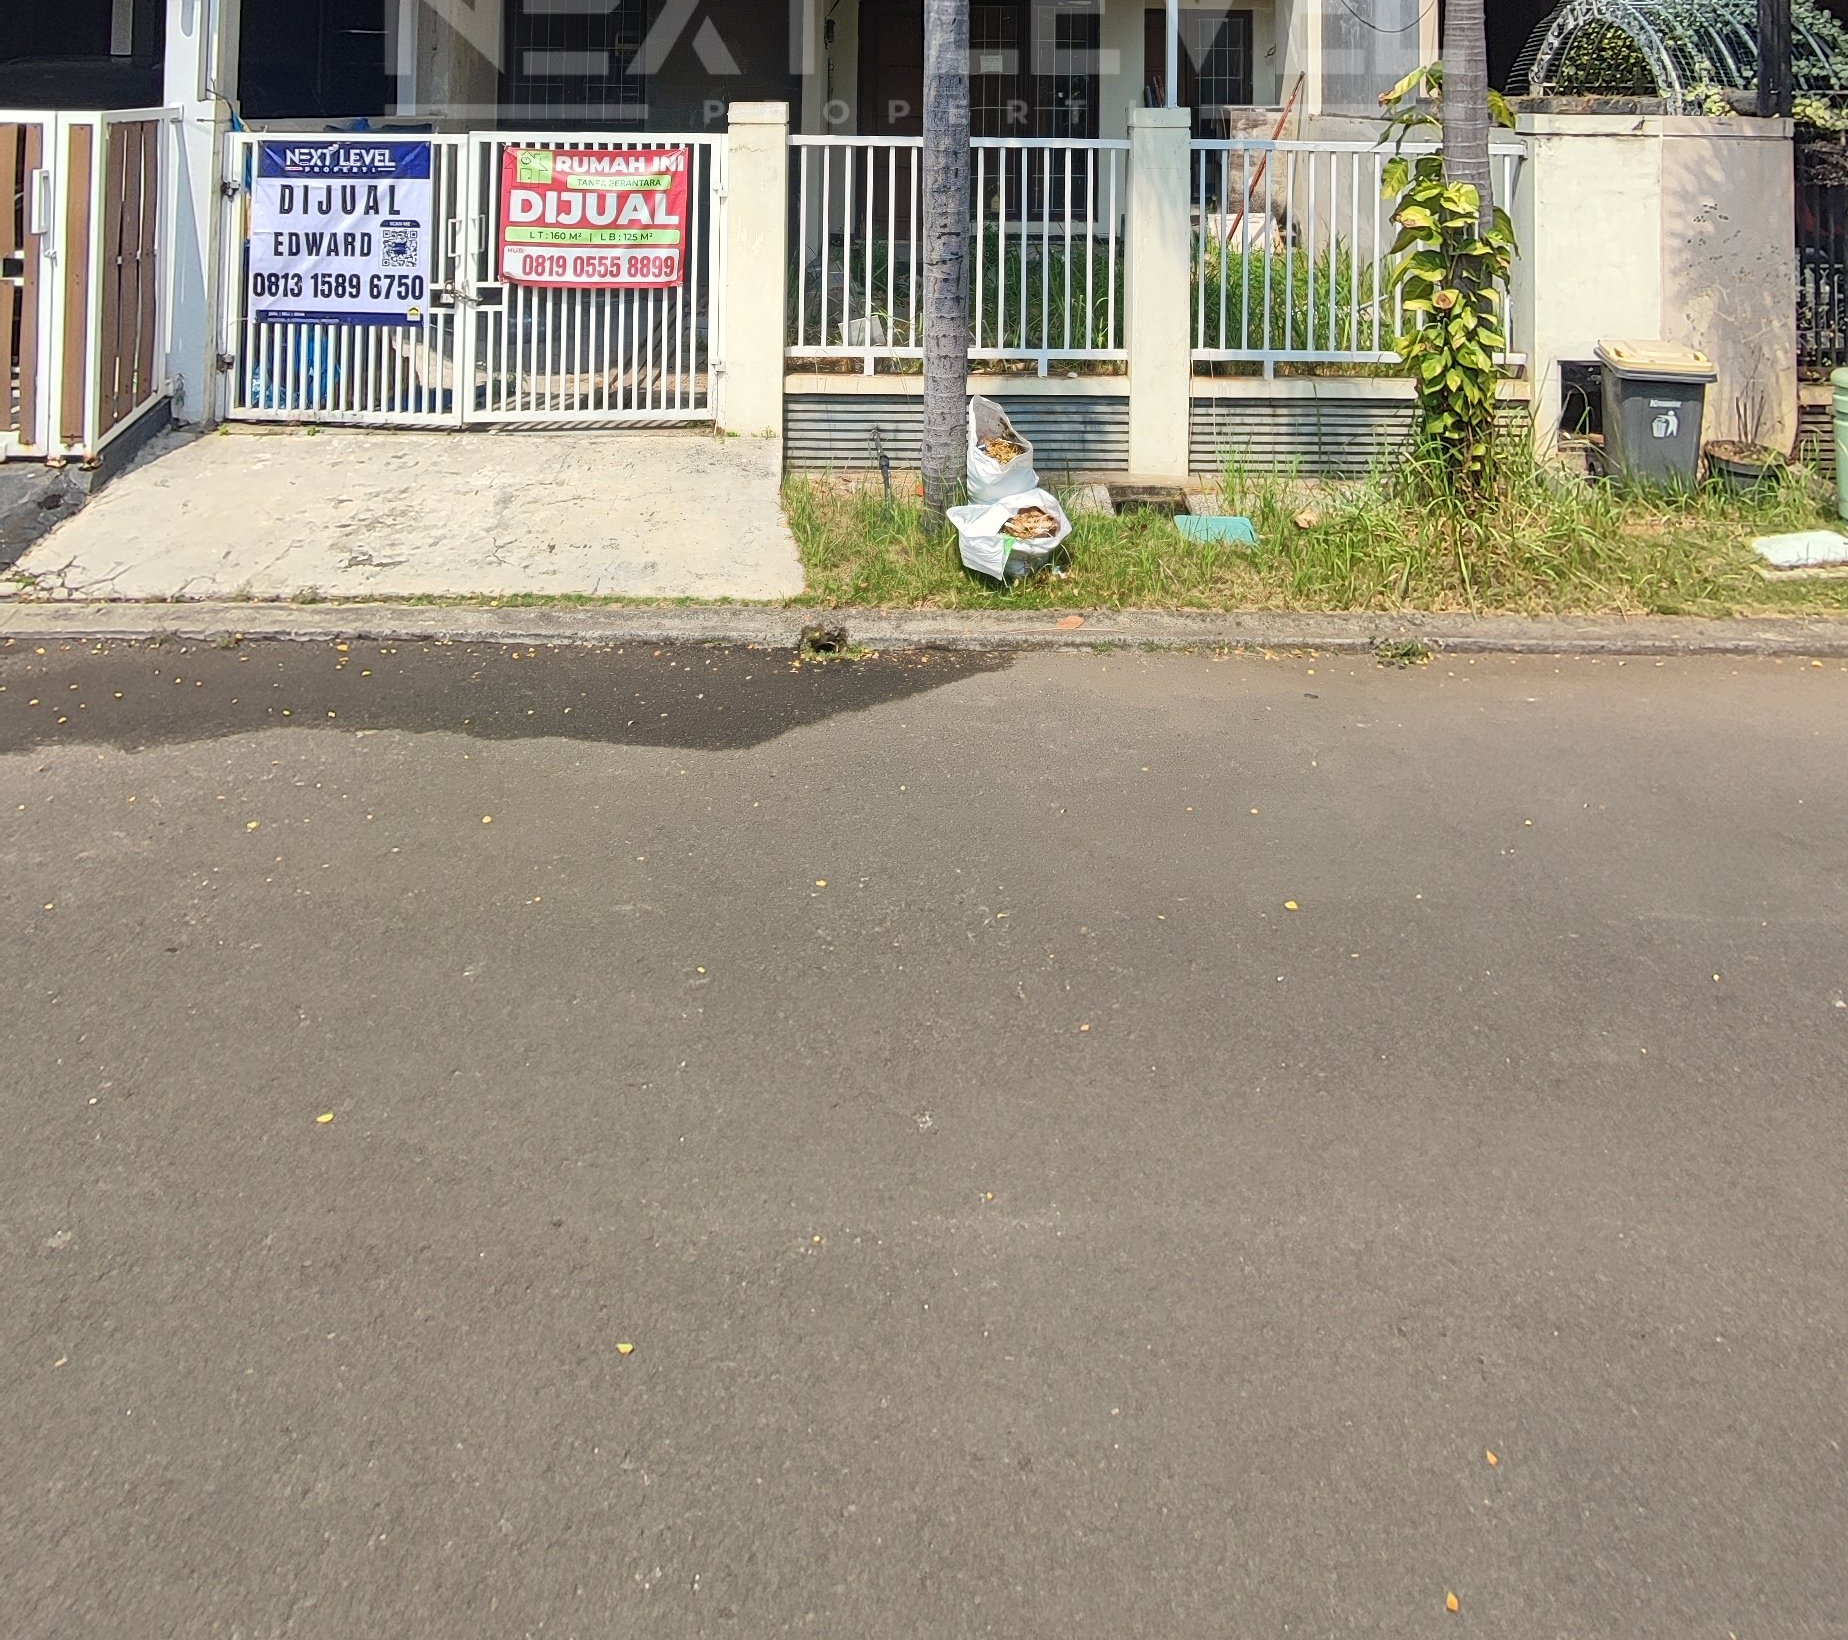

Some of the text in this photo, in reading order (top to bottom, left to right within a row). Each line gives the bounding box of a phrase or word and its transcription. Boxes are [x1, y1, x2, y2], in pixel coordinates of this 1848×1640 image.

[285, 148, 396, 166] NEXT LEVEL
[556, 156, 684, 174] RUMAH INI
[279, 183, 401, 216] DIJUAL
[509, 189, 679, 226] DIJUAL
[273, 231, 372, 258] EDWARD
[550, 231, 566, 241] 160
[623, 233, 638, 241] 125
[521, 254, 676, 279] 0819 0555 8899
[252, 272, 424, 301] 0813 1589 6750
